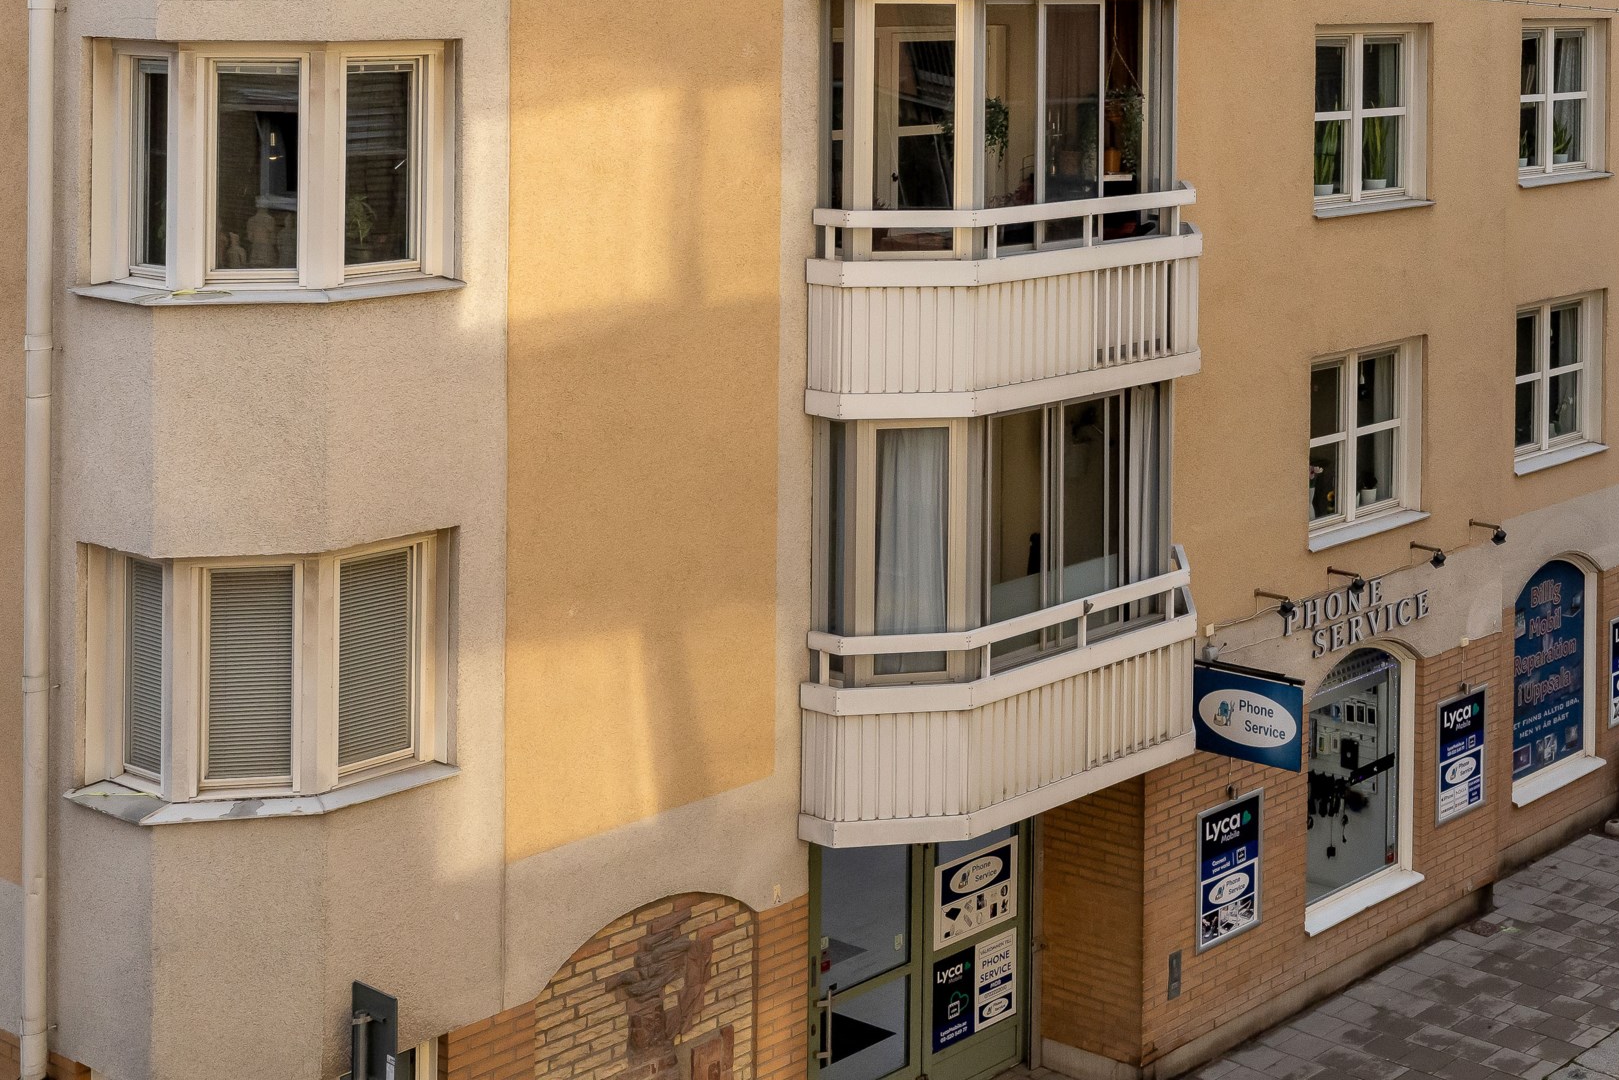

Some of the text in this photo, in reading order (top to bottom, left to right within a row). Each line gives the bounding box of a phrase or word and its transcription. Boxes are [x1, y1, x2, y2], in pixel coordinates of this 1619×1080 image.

[1530, 579, 1562, 608] Billig
[1283, 578, 1383, 637] PHONE
[1312, 589, 1430, 659] SERVICE
[1528, 606, 1562, 640] Mobil
[1514, 636, 1577, 678] Reparation
[1522, 666, 1571, 706] Uppsala
[1239, 699, 1274, 718] Phone
[1443, 704, 1472, 729] Lyca
[1522, 712, 1542, 727] FINNS
[1543, 703, 1565, 717] ALLTID
[1244, 719, 1286, 740] Service
[1455, 719, 1471, 731] Mobile
[1519, 727, 1534, 739] MEN
[1535, 724, 1542, 732] VI
[1458, 760, 1470, 770] Phone
[1459, 766, 1473, 776] Service
[1205, 812, 1241, 842] Lyca
[1220, 830, 1241, 844] Mobile
[971, 860, 992, 873] Phone
[1211, 856, 1227, 867] Connect
[1220, 861, 1231, 871] world
[974, 868, 998, 882] Service
[1225, 876, 1241, 887] Phone
[1228, 882, 1246, 895] Service
[981, 949, 1011, 970] PHONE
[936, 962, 964, 985] Lyca
[980, 962, 1012, 983] SERVICE
